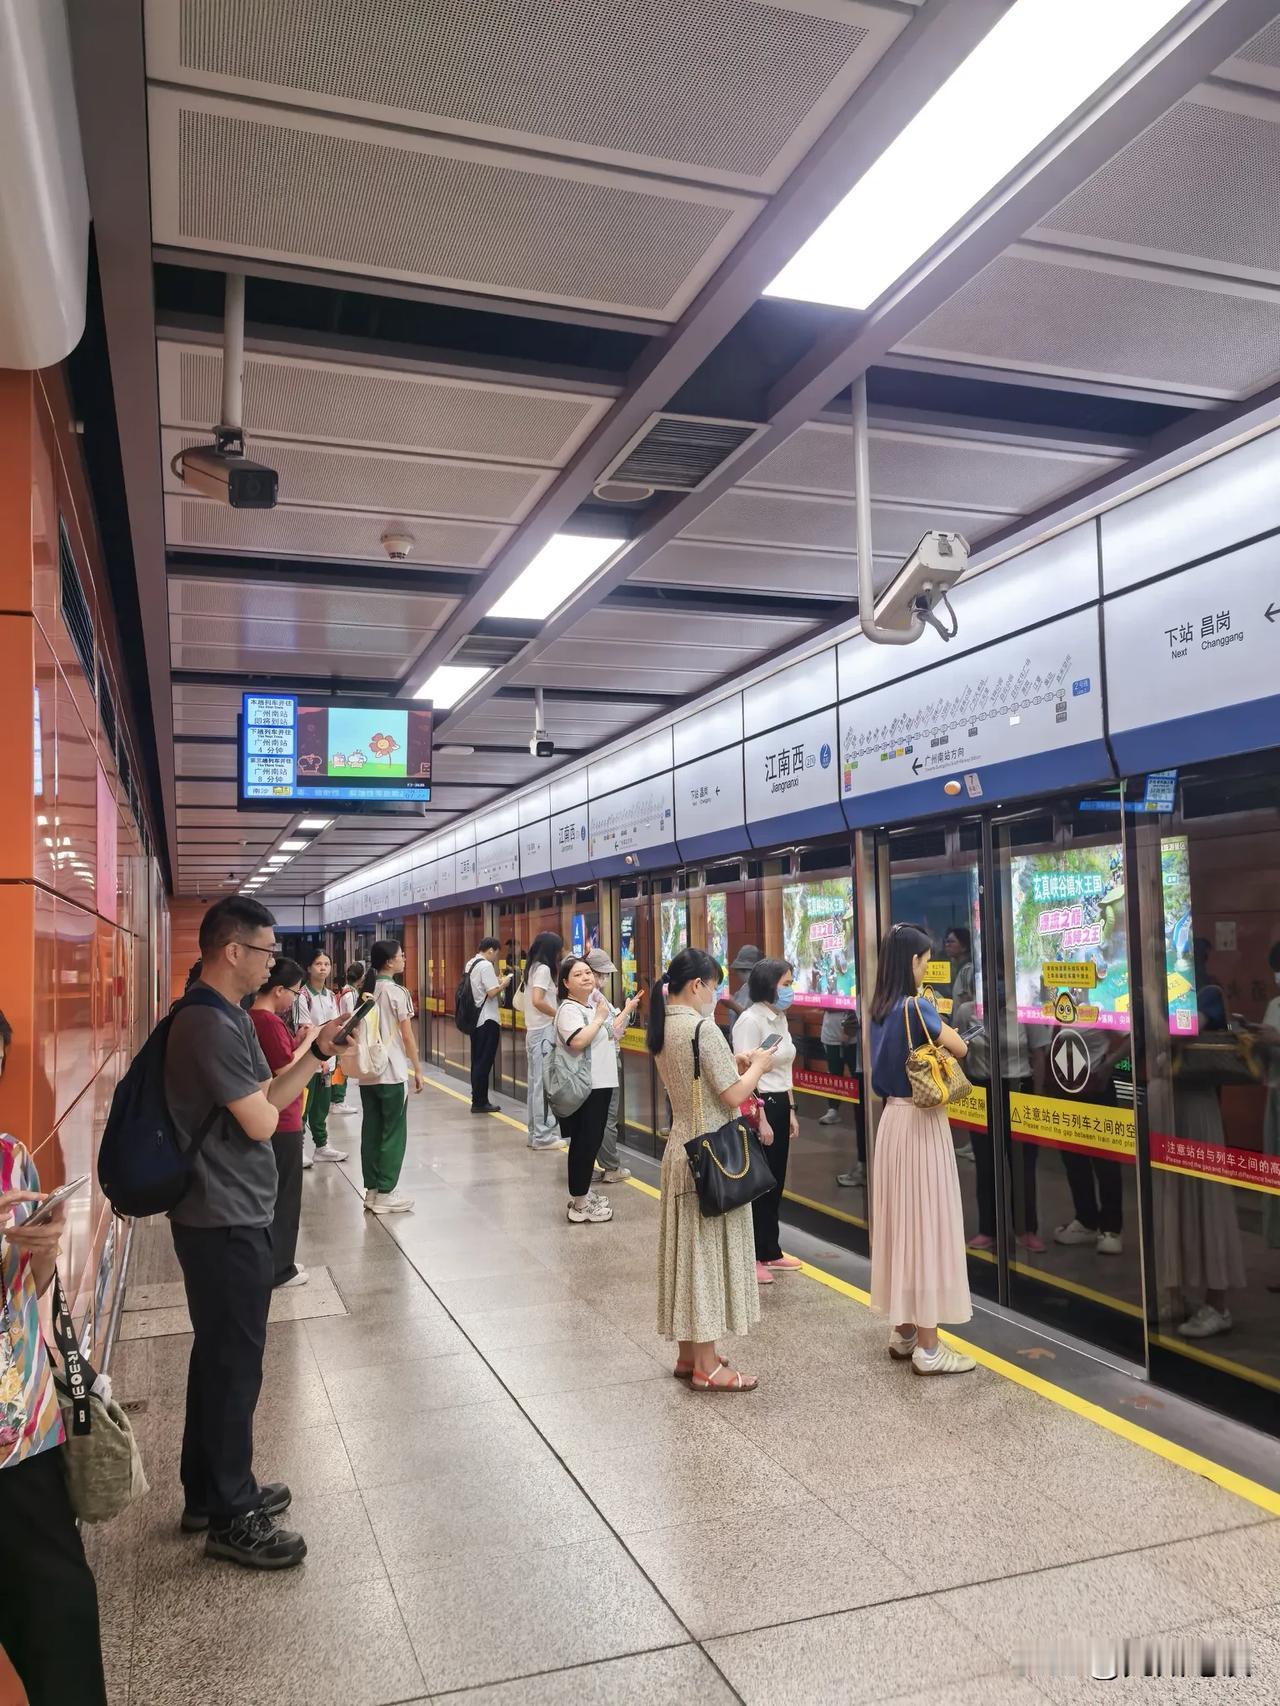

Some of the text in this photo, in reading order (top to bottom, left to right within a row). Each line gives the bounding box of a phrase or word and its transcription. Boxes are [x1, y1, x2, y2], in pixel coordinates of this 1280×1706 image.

[1165, 610, 1231, 648] 下站 昌岗
[1171, 632, 1244, 660] Next Changgang
[254, 710, 288, 718] 广州南站
[254, 739, 288, 747] 广州南站
[765, 744, 804, 782] 江南西
[924, 747, 965, 767] 广州南站方向
[254, 768, 288, 776] 广州南站
[771, 776, 799, 794] Jiangnanxi
[1023, 1106, 1136, 1138] 注意站台与列车之间的空
[1023, 1121, 1039, 1130] Please
[1040, 1124, 1052, 1132] mind
[1074, 1131, 1096, 1141] between
[1111, 1138, 1122, 1146] and
[1167, 1141, 1280, 1175] 注意站台与列车之间的高
